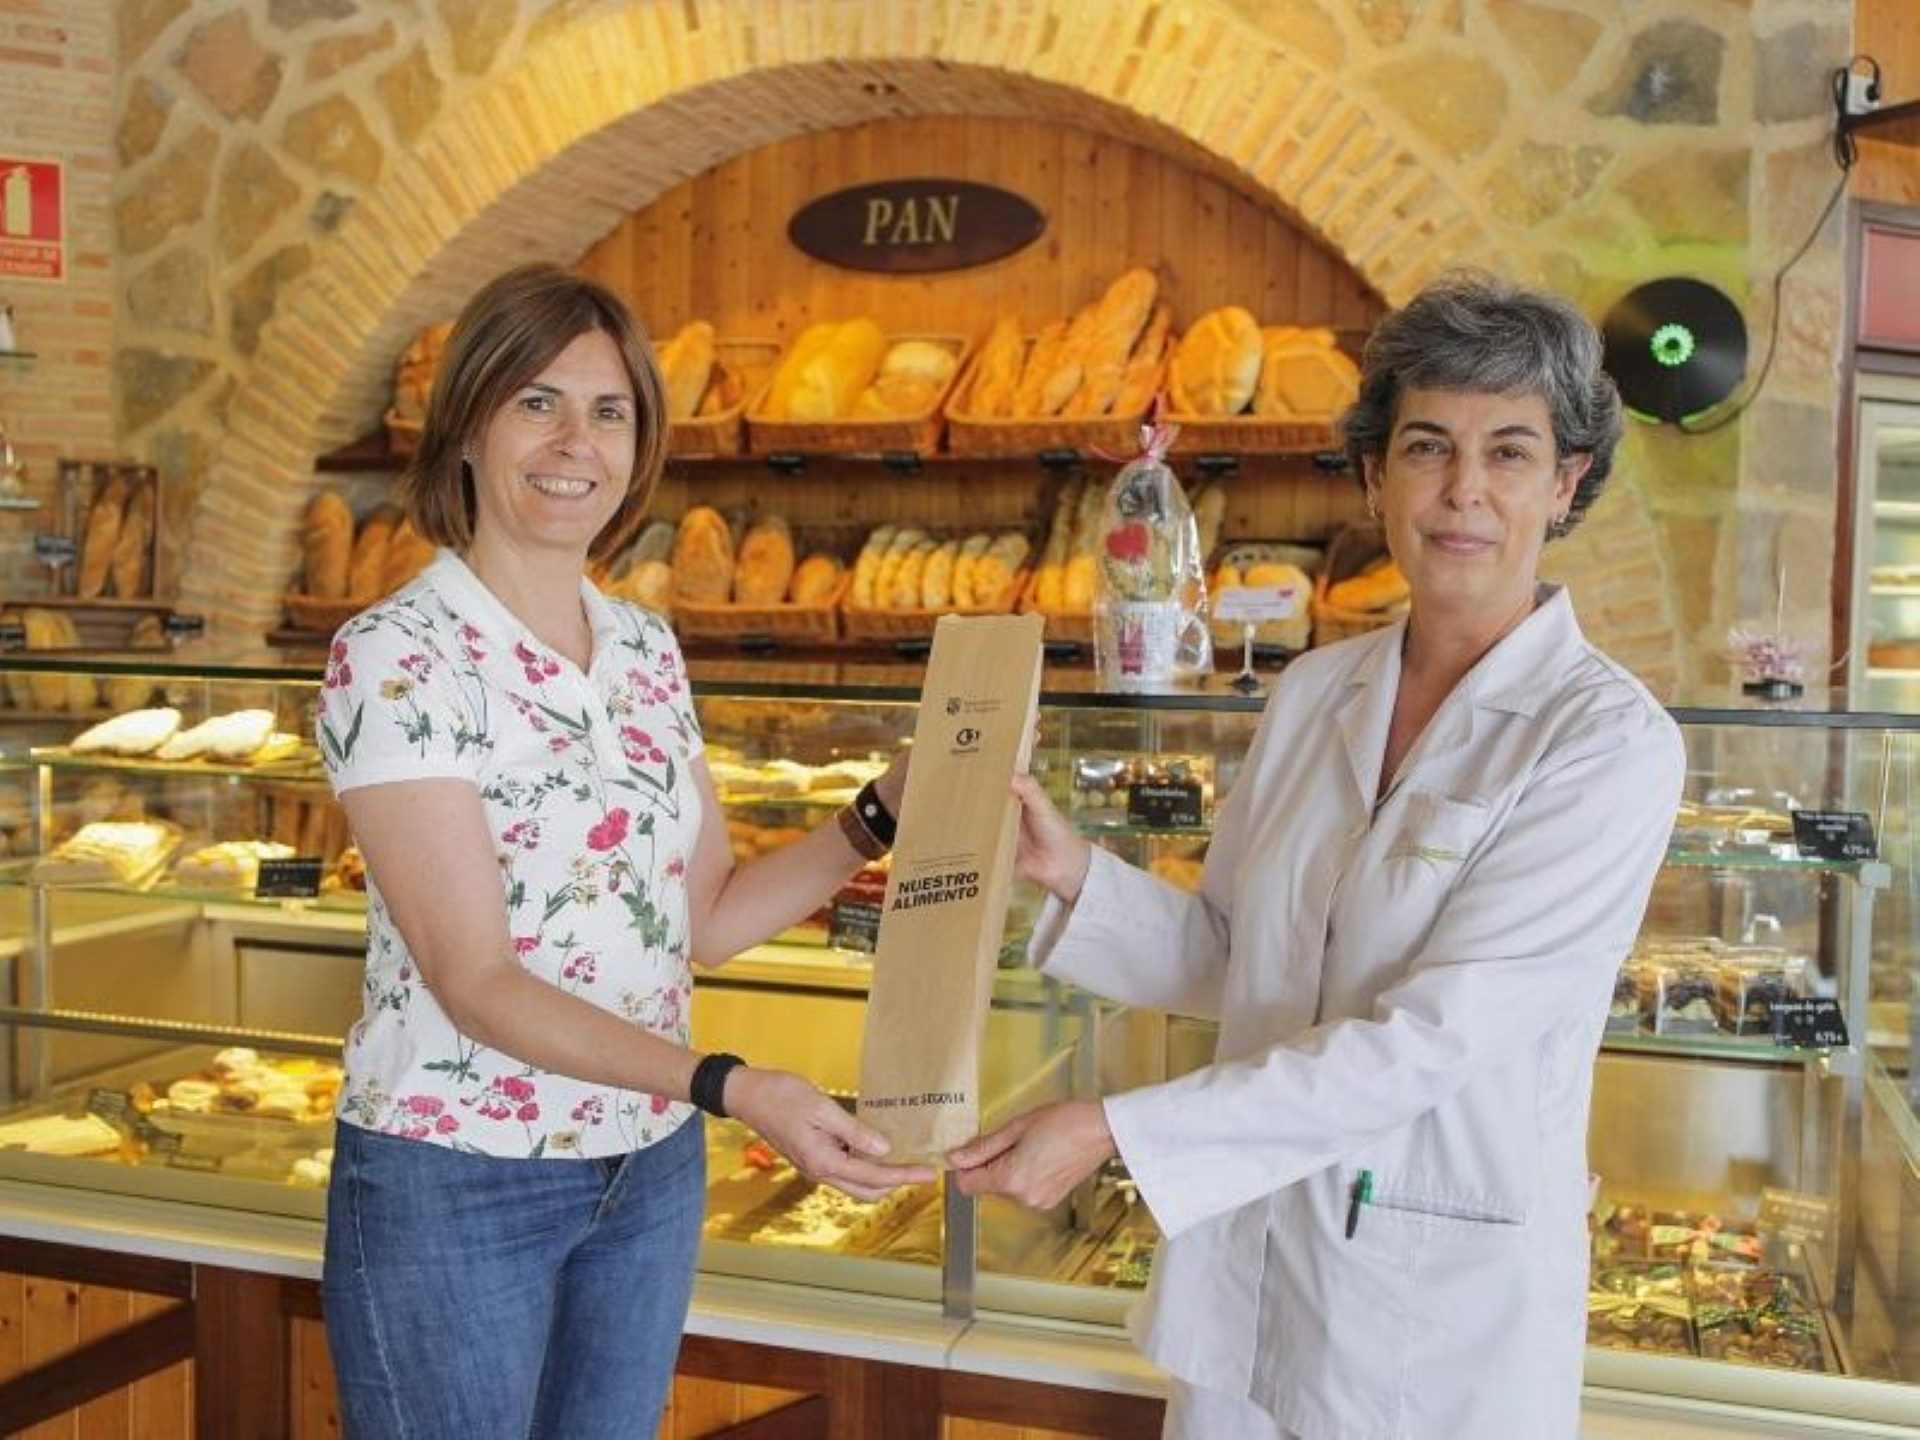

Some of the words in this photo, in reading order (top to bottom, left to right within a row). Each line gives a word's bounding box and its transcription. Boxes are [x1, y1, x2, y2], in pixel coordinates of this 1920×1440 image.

[862, 194, 958, 245] PAN
[898, 871, 979, 894] NUESTRO
[891, 884, 979, 912] ALIMENTO
[921, 1093, 964, 1106] SEGOVIA
